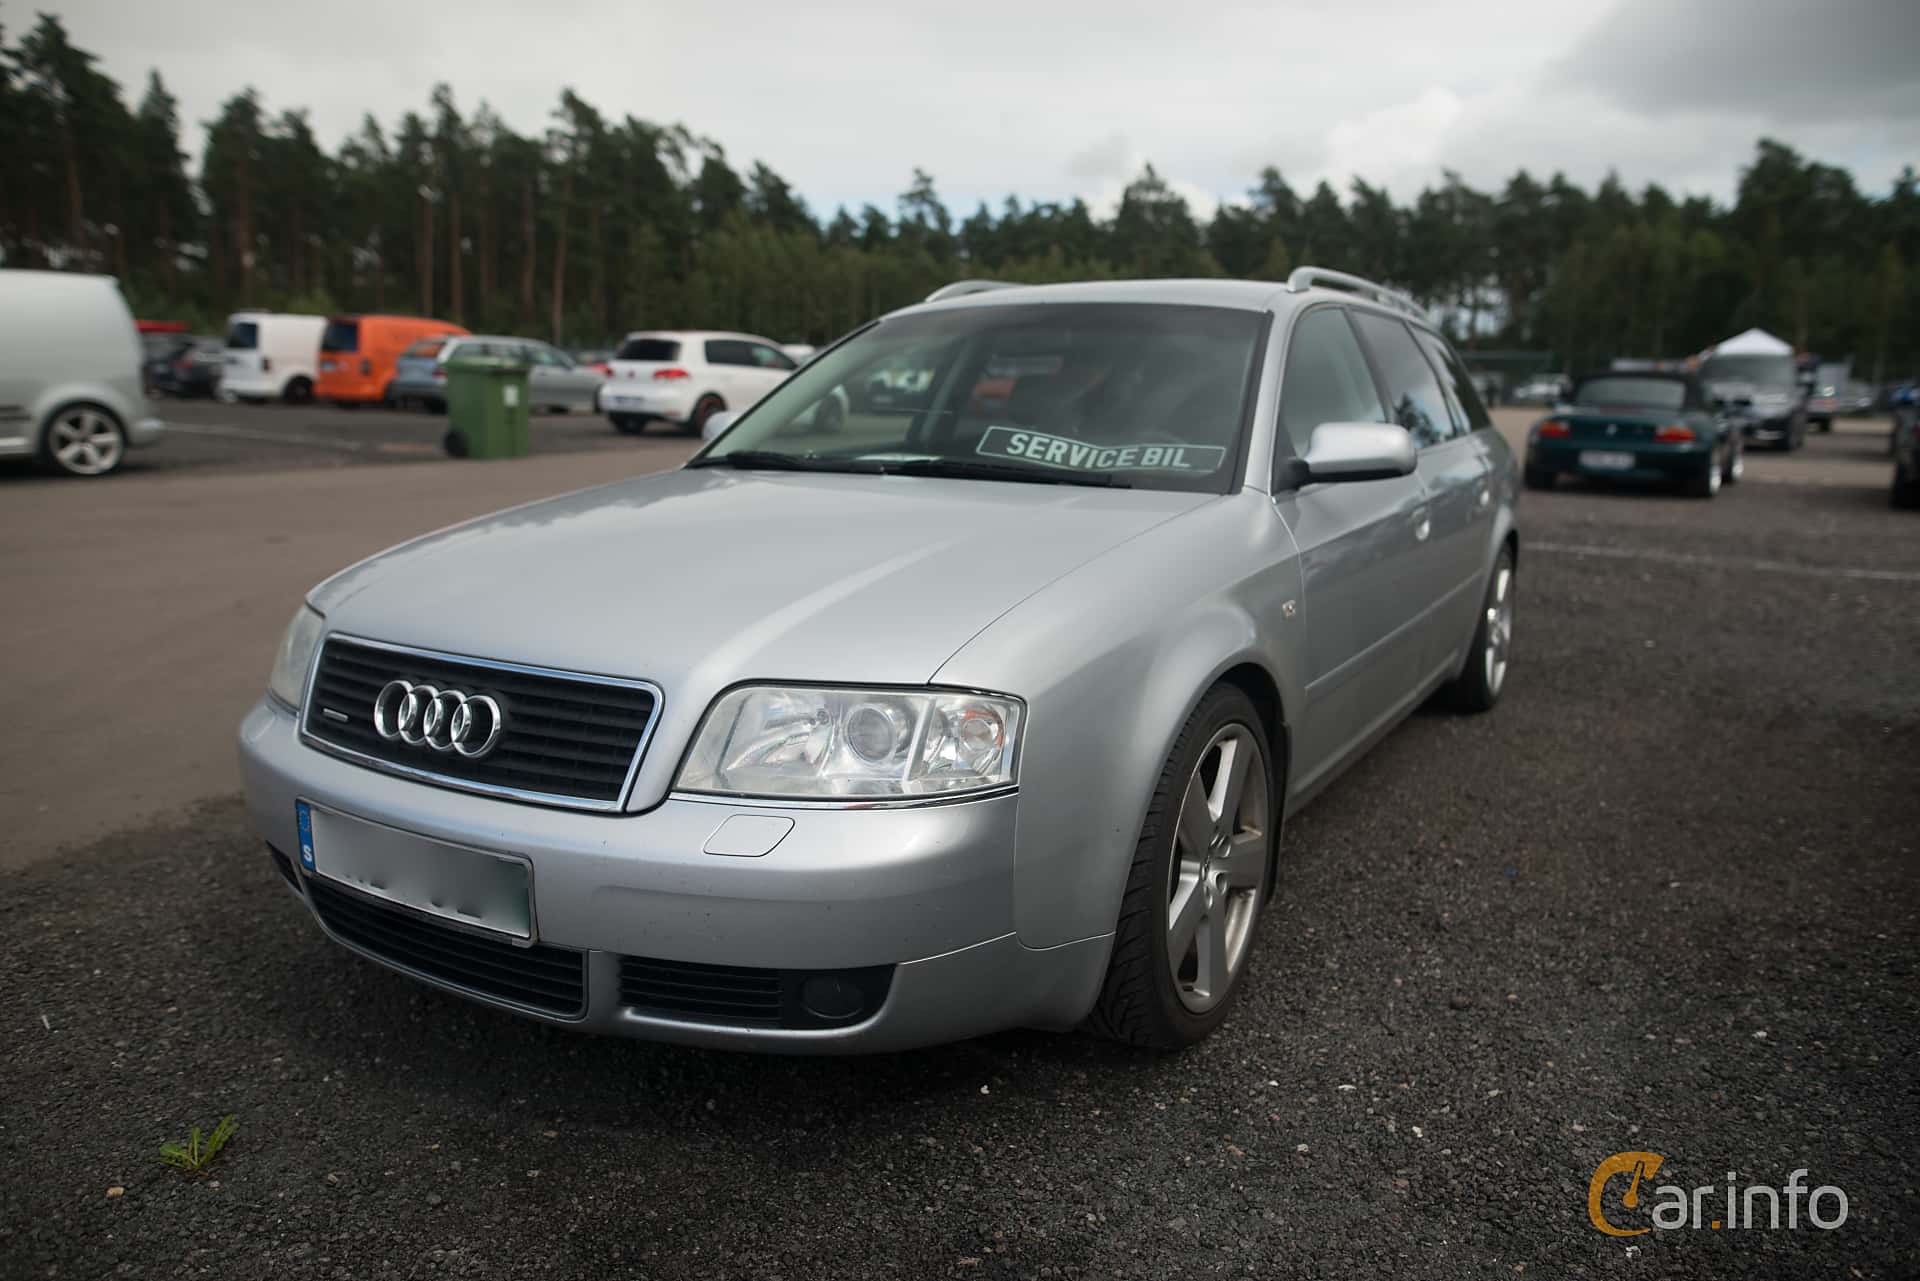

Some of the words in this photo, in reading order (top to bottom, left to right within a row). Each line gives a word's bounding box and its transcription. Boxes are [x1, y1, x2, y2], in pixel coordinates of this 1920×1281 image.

[1007, 433, 1139, 469] SERVICE
[1141, 447, 1192, 468] BIL
[303, 844, 313, 862] S
